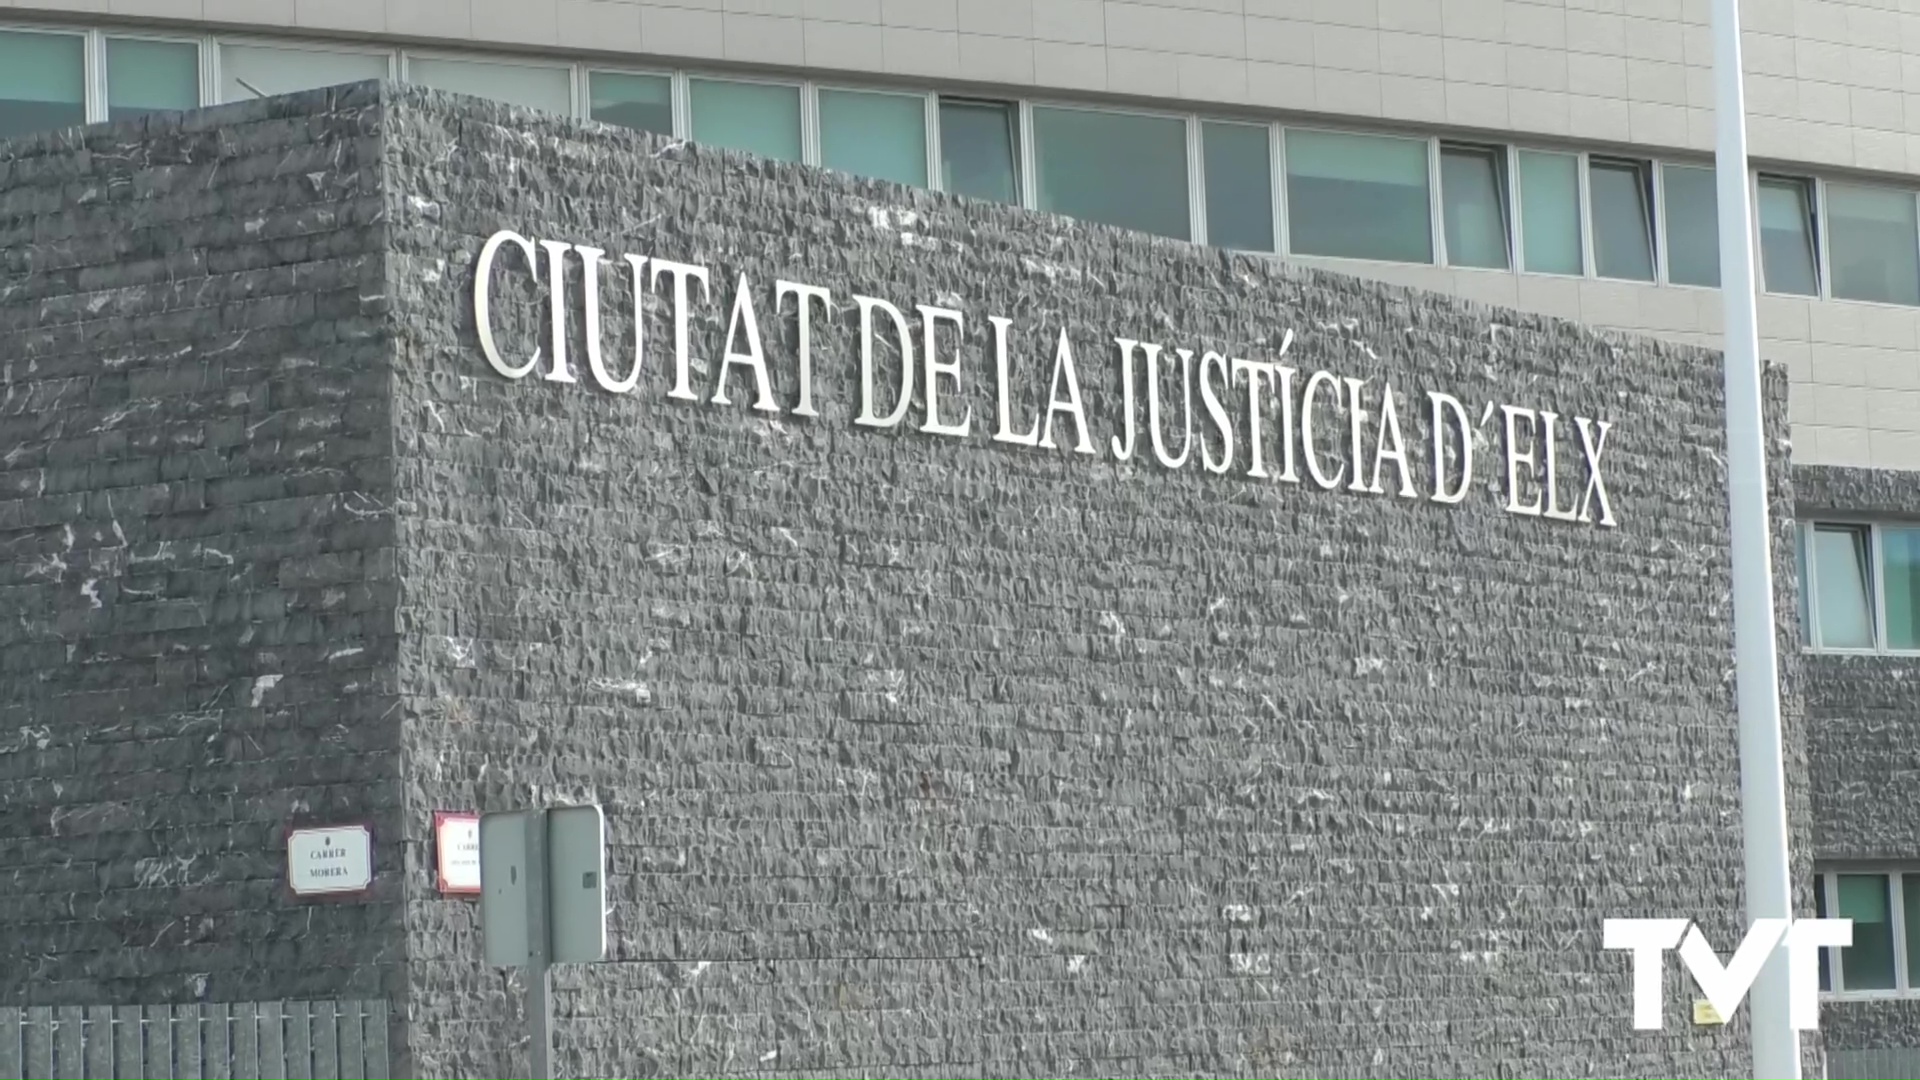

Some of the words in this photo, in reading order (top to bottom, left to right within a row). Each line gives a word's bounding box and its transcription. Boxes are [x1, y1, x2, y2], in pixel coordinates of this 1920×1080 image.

[474, 230, 831, 416] CIUTAT
[852, 294, 971, 437] DE
[988, 315, 1096, 453] LA
[1111, 328, 1418, 498] JUSTÍCIA
[310, 848, 346, 860] CARRER
[310, 867, 348, 878] MORERA
